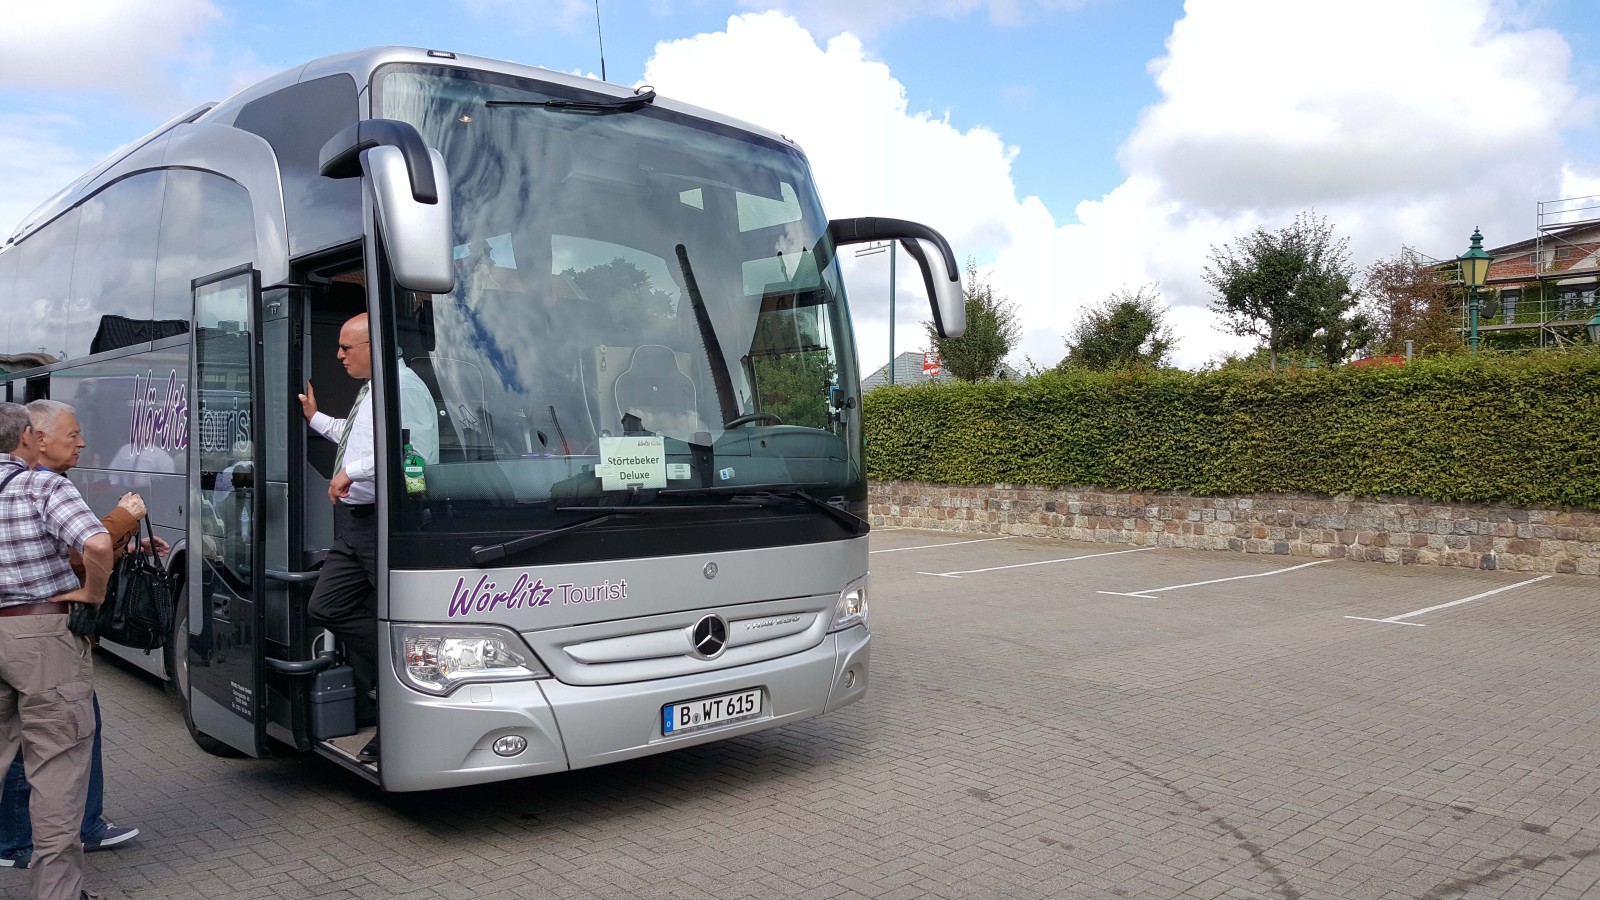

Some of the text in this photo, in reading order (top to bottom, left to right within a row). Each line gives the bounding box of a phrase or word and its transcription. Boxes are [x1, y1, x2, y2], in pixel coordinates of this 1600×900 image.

[202, 396, 251, 453] ouris
[607, 455, 660, 466] Störtebeker
[619, 470, 650, 480] Deluxe
[448, 572, 628, 618] Wörlitz Tourist
[680, 706, 691, 726] B
[702, 700, 723, 721] WT
[726, 693, 755, 716] 615
